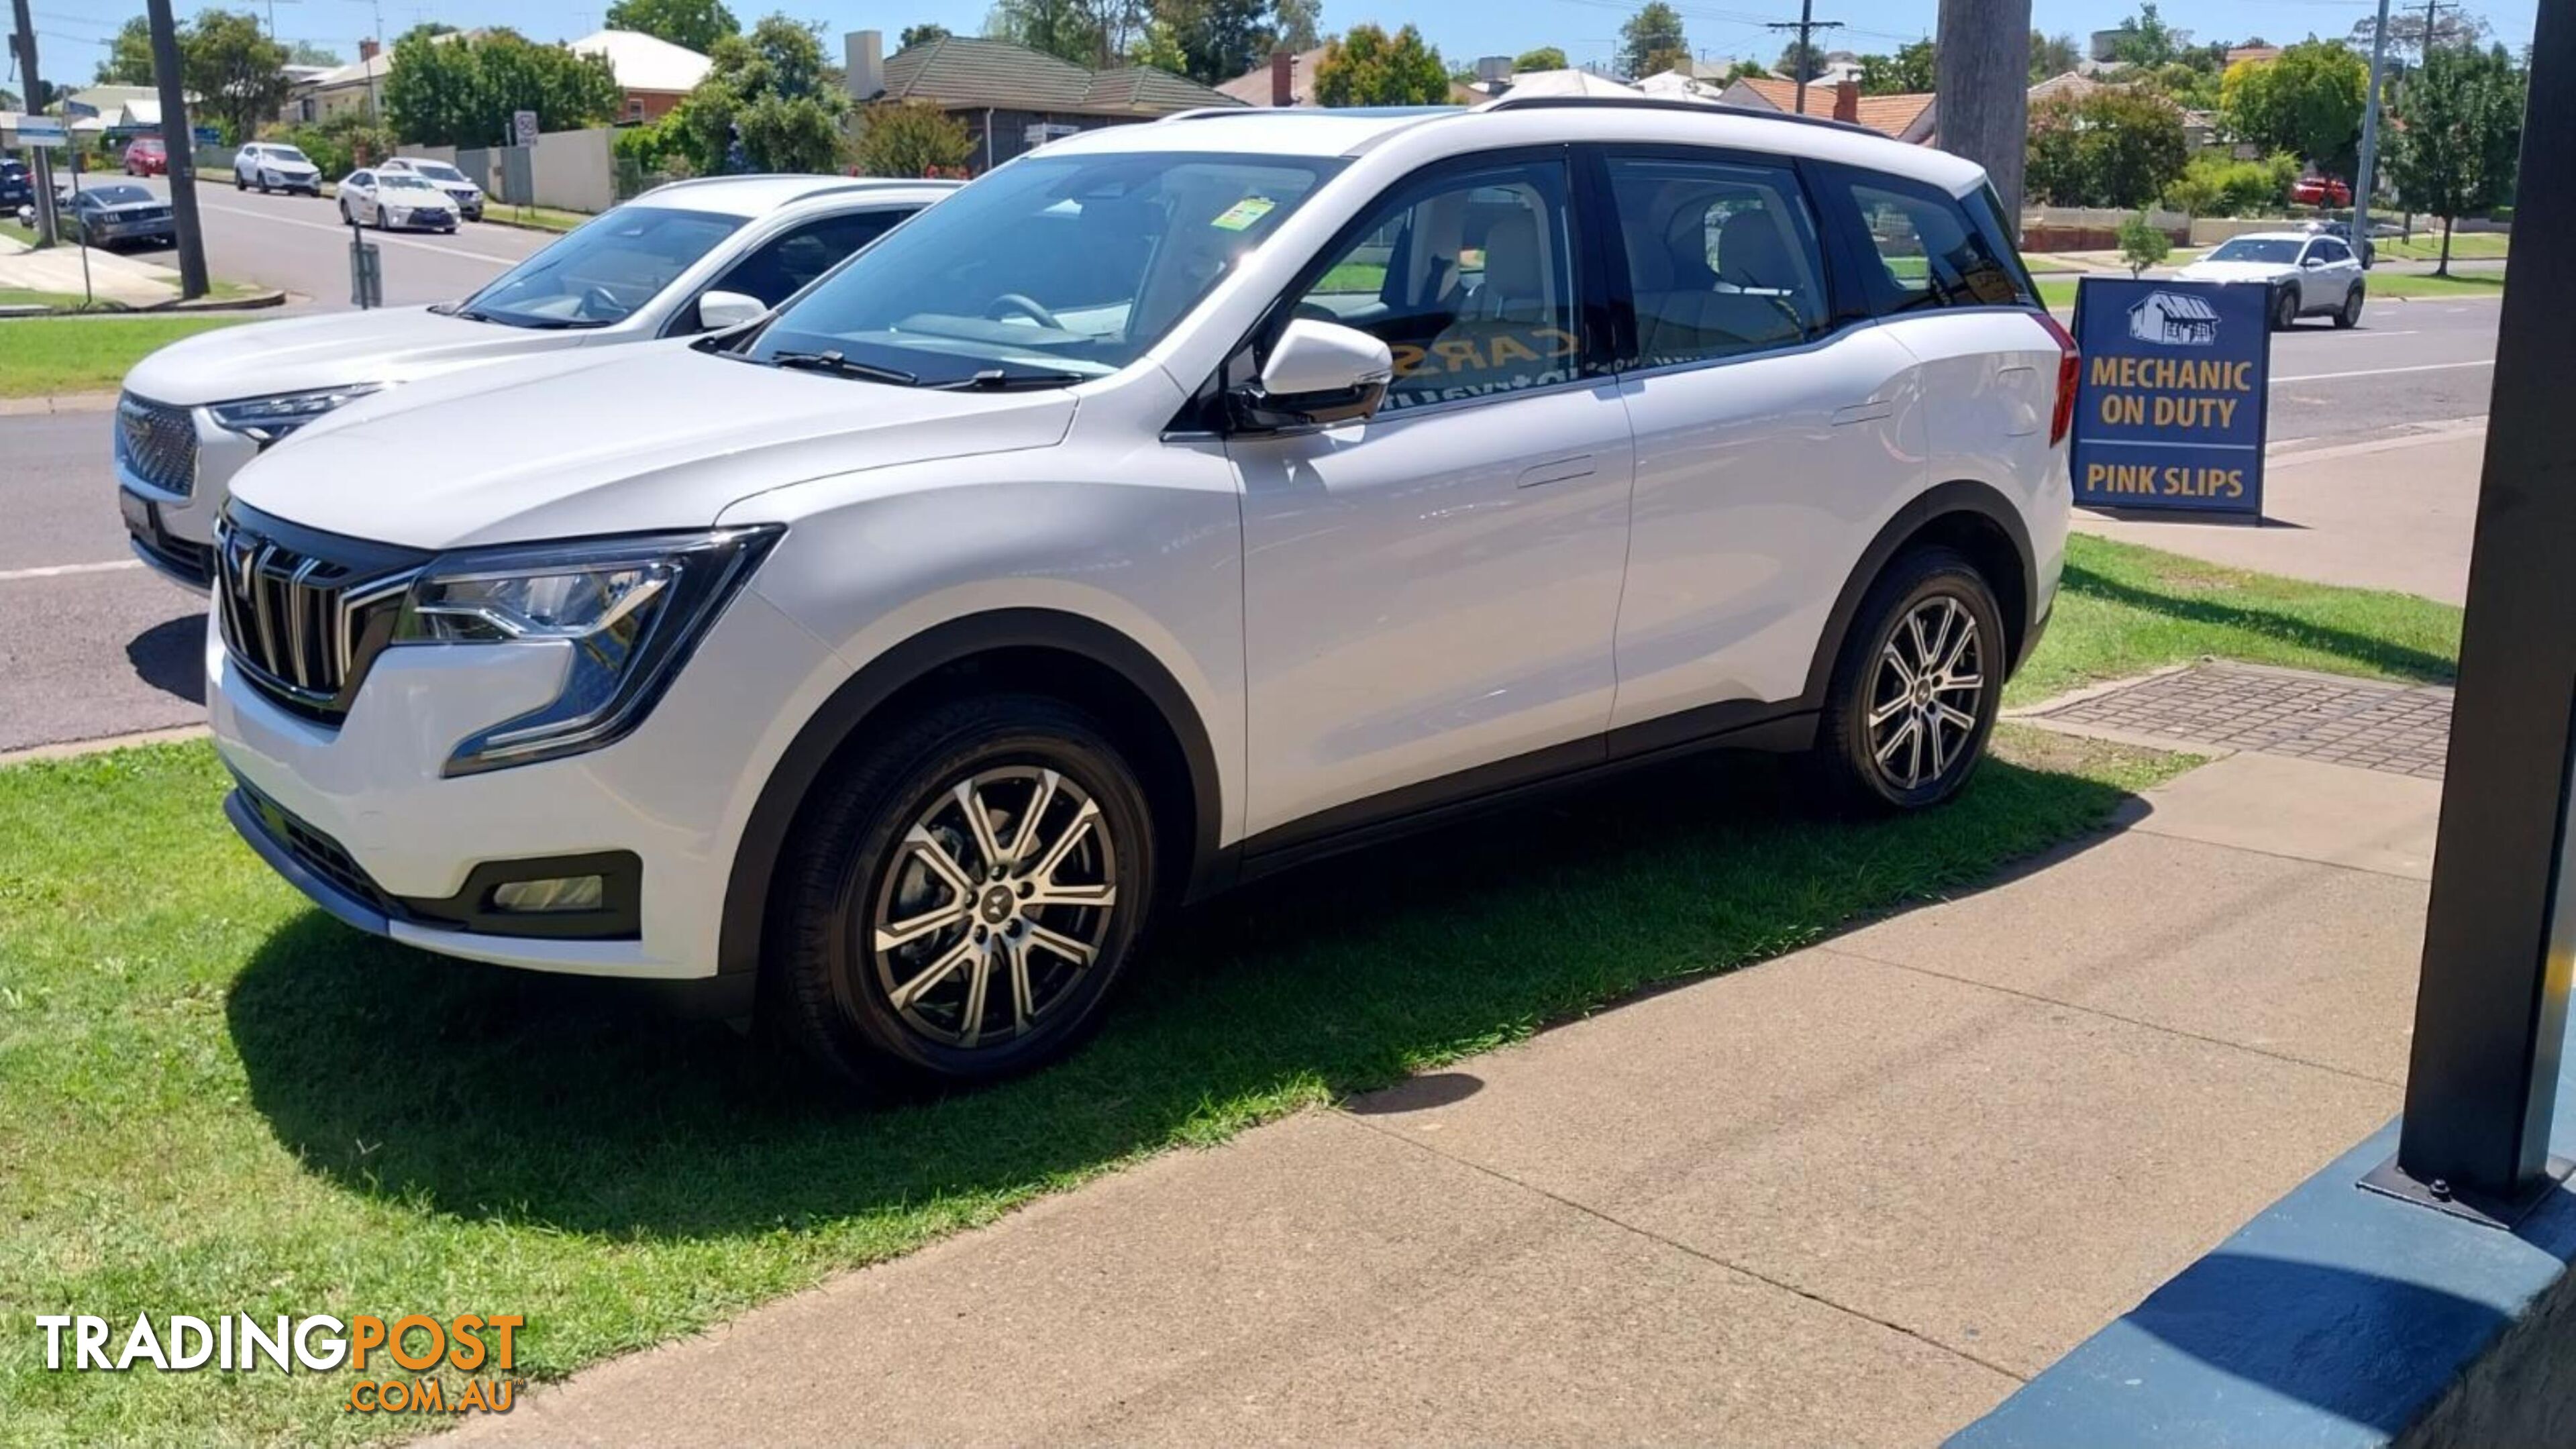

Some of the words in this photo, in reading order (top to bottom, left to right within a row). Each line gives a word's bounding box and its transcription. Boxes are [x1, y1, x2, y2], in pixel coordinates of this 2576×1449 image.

[2090, 357, 2253, 391] MECHANIC
[2101, 394, 2145, 425] ON
[2154, 396, 2238, 429] DUTY
[2087, 464, 2158, 494] PINK
[2163, 468, 2245, 498] SLIPS
